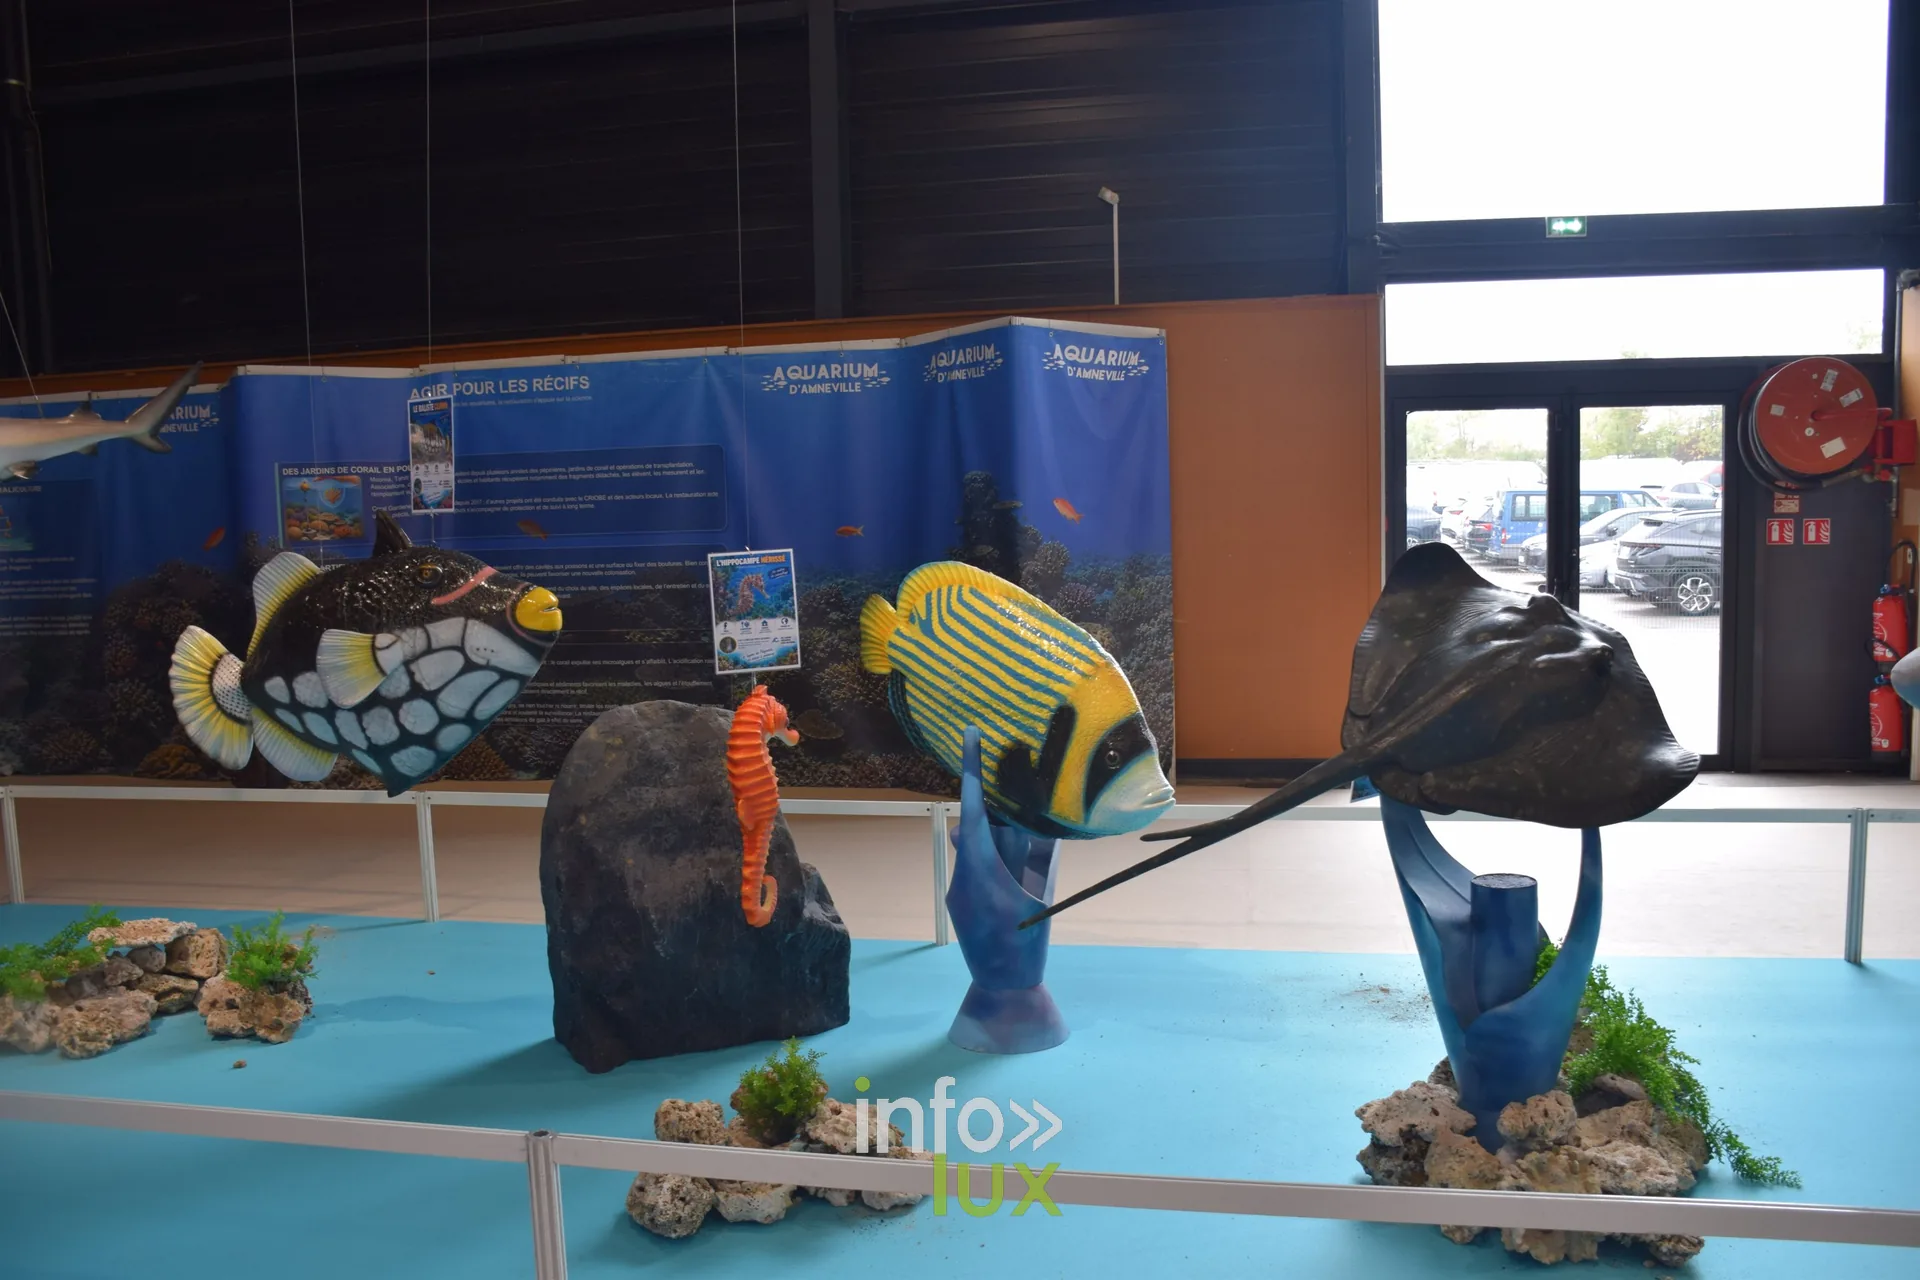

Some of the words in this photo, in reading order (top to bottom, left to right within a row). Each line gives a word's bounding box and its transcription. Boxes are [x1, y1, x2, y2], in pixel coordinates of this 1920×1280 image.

[930, 343, 995, 371] AQUARIUM
[1053, 343, 1141, 366] AQUARIUM
[773, 362, 879, 381] AQUARIUM
[1067, 366, 1126, 381] D'AMNEVILLE
[410, 383, 448, 399] AGIR
[453, 380, 496, 396] POUR
[499, 378, 528, 394] LES
[532, 374, 590, 392] RÉCIFS
[789, 382, 861, 395] D'AMNEVILLE
[282, 468, 299, 476] DES
[300, 467, 335, 475] JARDINS
[337, 466, 348, 474] DE
[351, 466, 381, 474] CORAIL
[383, 465, 394, 473] EN
[716, 556, 760, 567] L'HIPPOCAMPE
